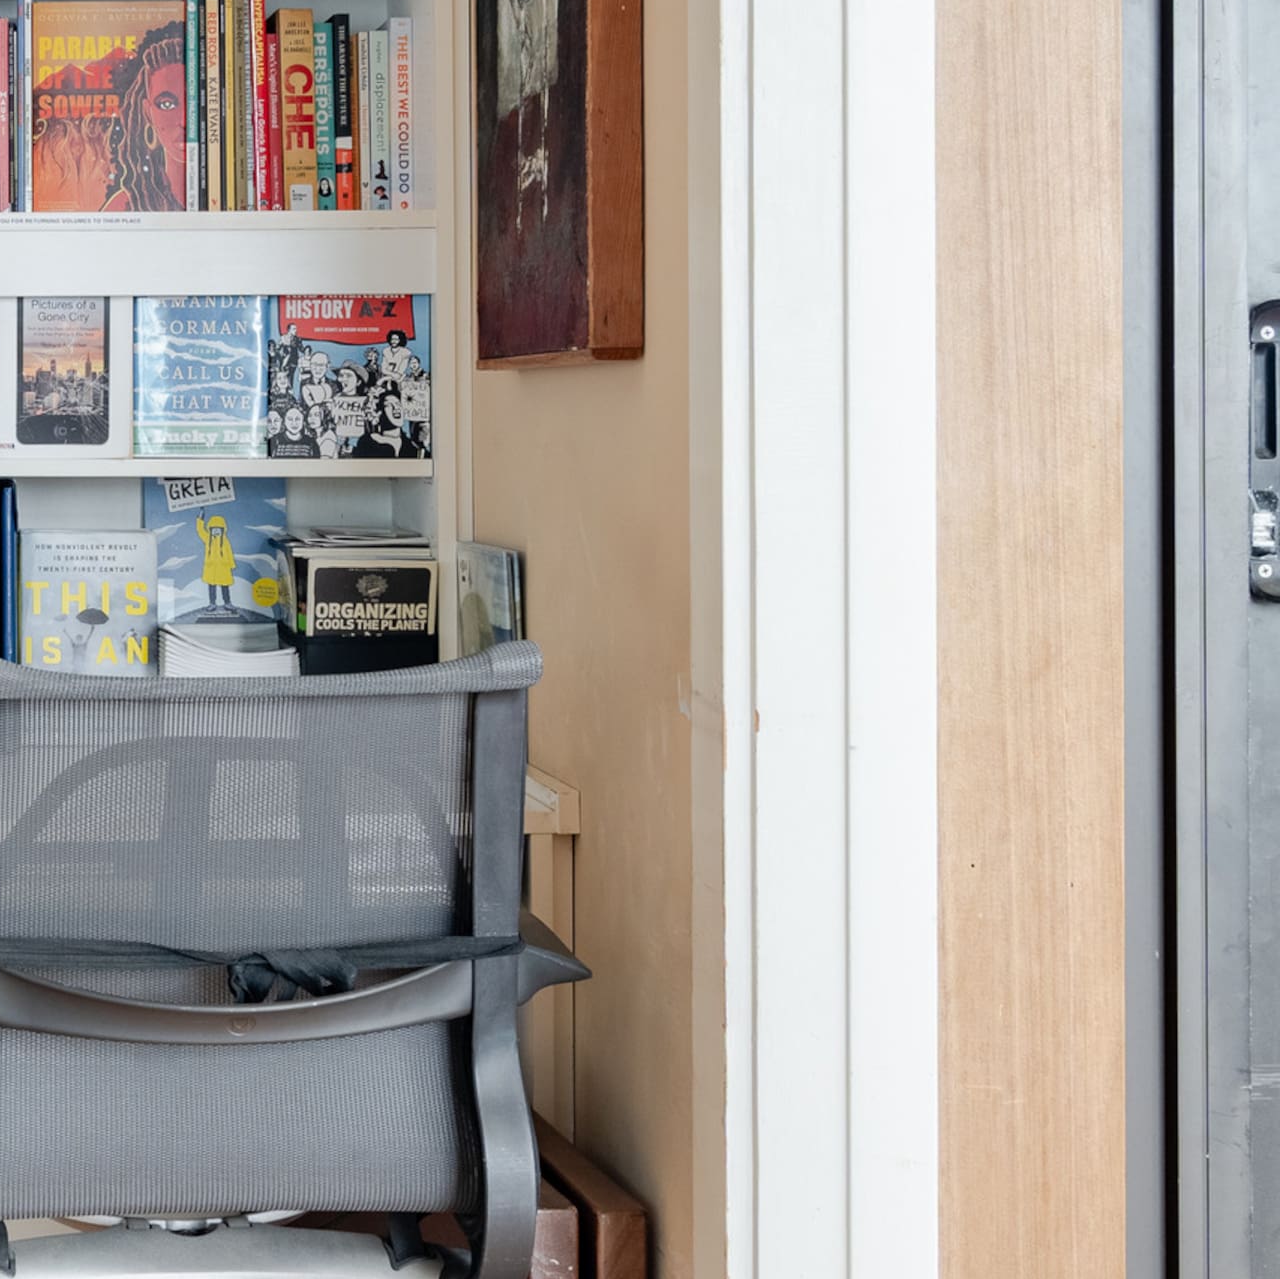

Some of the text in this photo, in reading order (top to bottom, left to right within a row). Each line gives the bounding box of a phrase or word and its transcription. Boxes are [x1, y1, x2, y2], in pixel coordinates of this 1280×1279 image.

[38, 35, 137, 60] PARABLE
[40, 64, 113, 90] OF THE
[208, 12, 219, 144] RED ROSA KATE EVANS
[314, 32, 329, 155] PERSEPOLIS
[39, 94, 120, 119] SOWER
[284, 63, 315, 150] CHE
[374, 72, 386, 153] displacement
[397, 35, 409, 193] THE BEST WE COULD DO
[31, 299, 96, 311] Pictures of a
[285, 299, 354, 320] HISTORY
[38, 312, 90, 324] Gone City
[169, 476, 231, 500] GRETA
[24, 581, 149, 616] THIS
[315, 603, 428, 620] ORGANIZING
[316, 619, 427, 630] COOLS THE PLANET
[25, 636, 149, 664] IS AN
